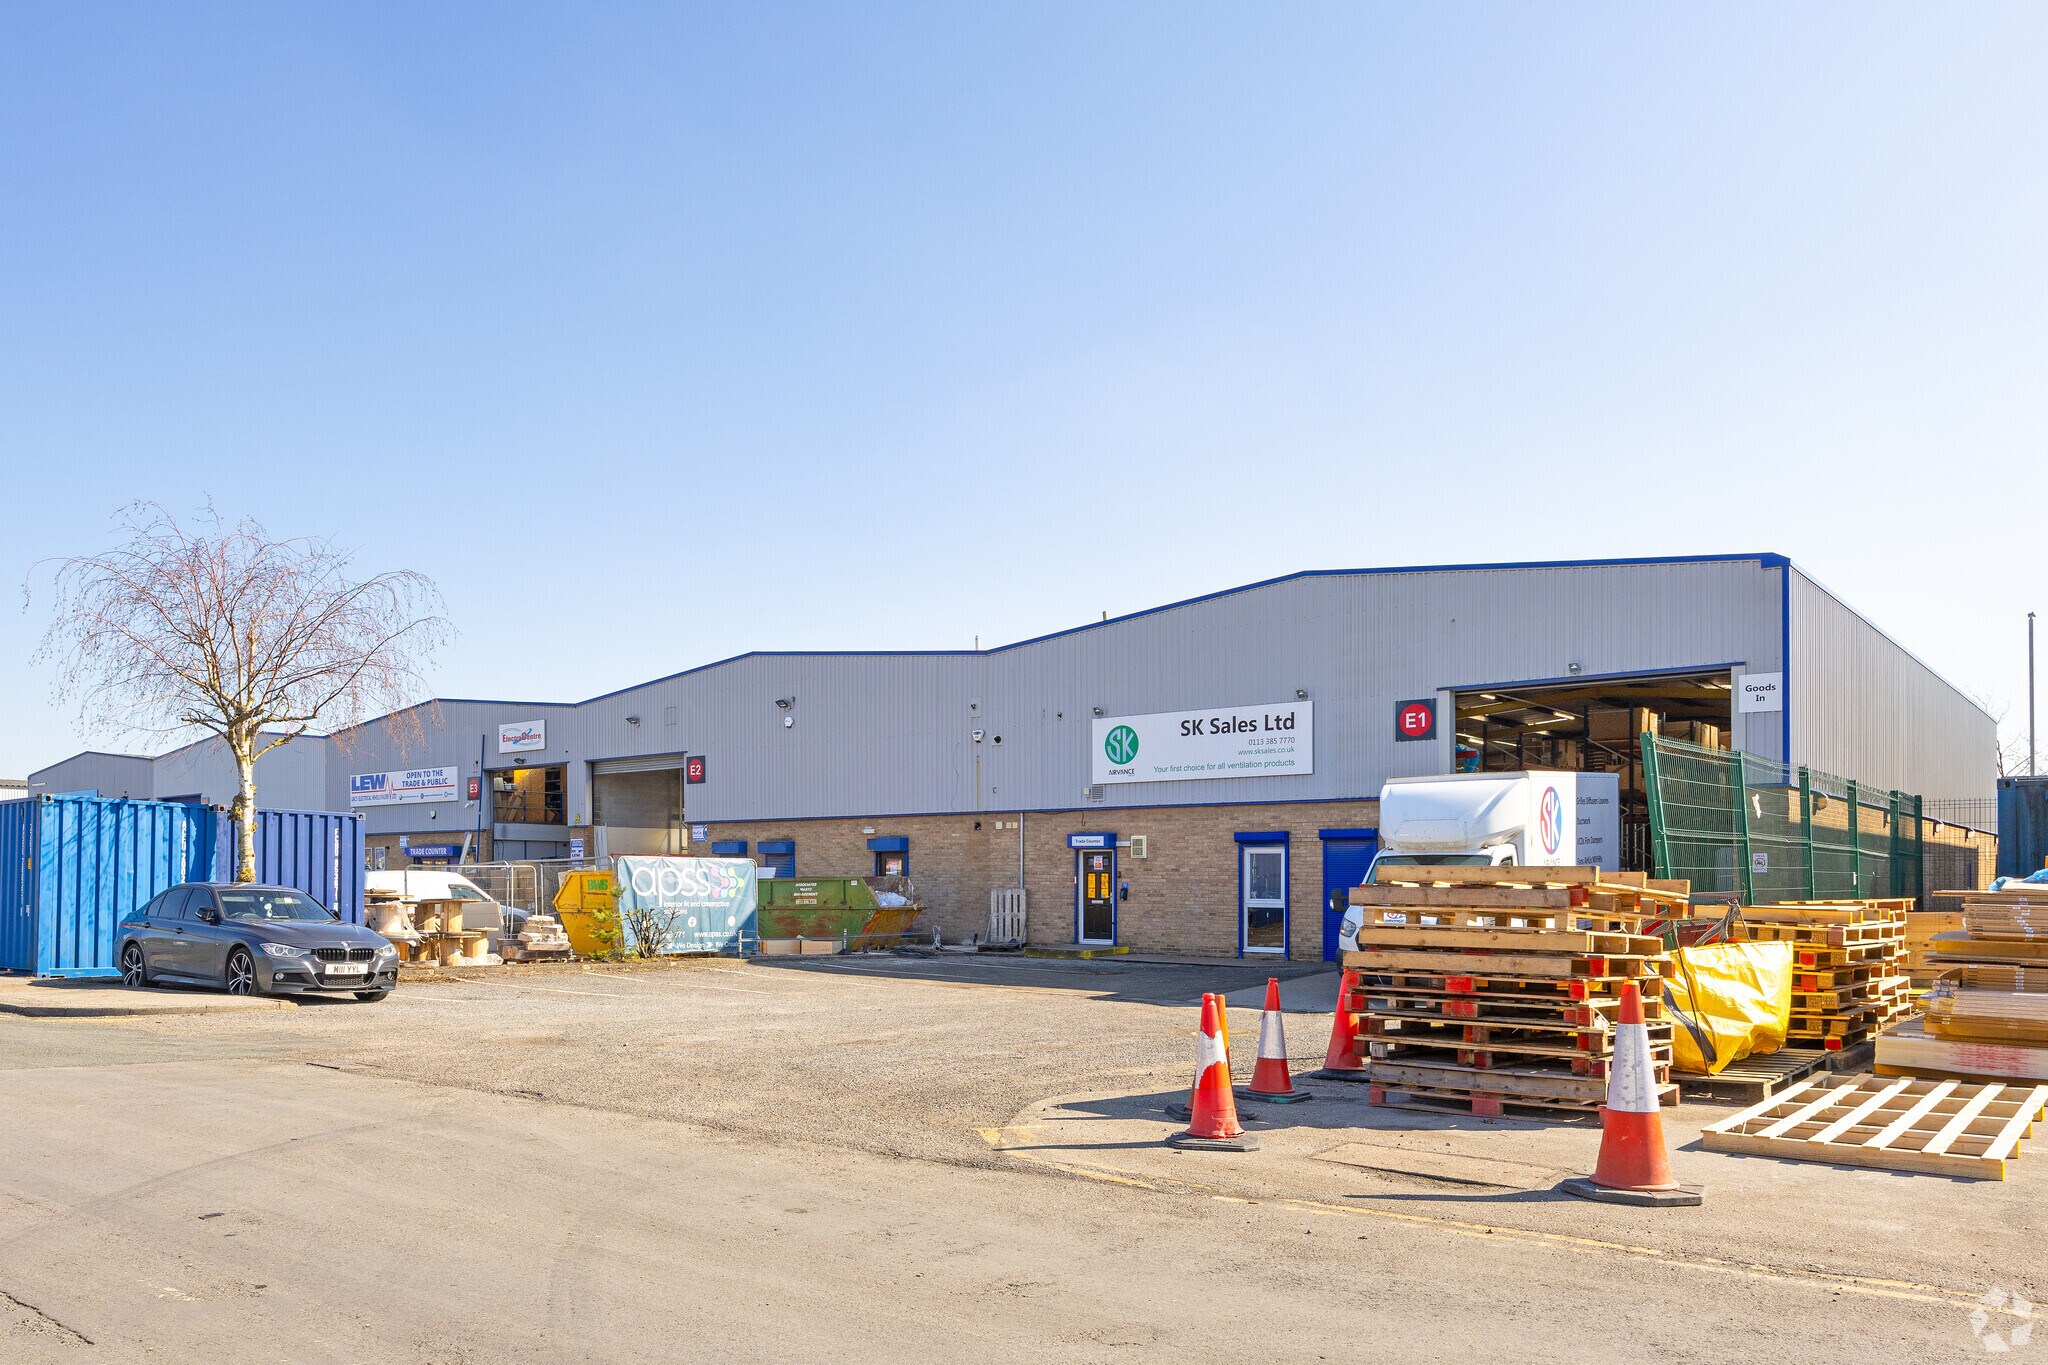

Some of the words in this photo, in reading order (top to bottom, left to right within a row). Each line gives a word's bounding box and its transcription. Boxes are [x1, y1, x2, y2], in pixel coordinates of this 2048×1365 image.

[1745, 683, 1776, 692] Goods
[1181, 719, 1204, 736] SK
[1210, 716, 1257, 734] Sales
[1264, 712, 1294, 731] Ltd
[1406, 712, 1426, 728] E1
[1106, 727, 1136, 763] SK
[1238, 746, 1294, 755] www.sksales.co.uk
[1227, 761, 1262, 769] ventilation
[1264, 759, 1294, 768] products
[406, 770, 421, 779] OPEN
[423, 770, 432, 778] TO
[690, 765, 701, 776] E2
[352, 774, 386, 791] LEW
[402, 779, 420, 788] TRADE
[427, 778, 448, 786] PUBLIC
[470, 784, 478, 793] E3
[1541, 788, 1560, 853] SK
[632, 866, 712, 907] apss
[694, 930, 737, 938] www.apss.co.uk
